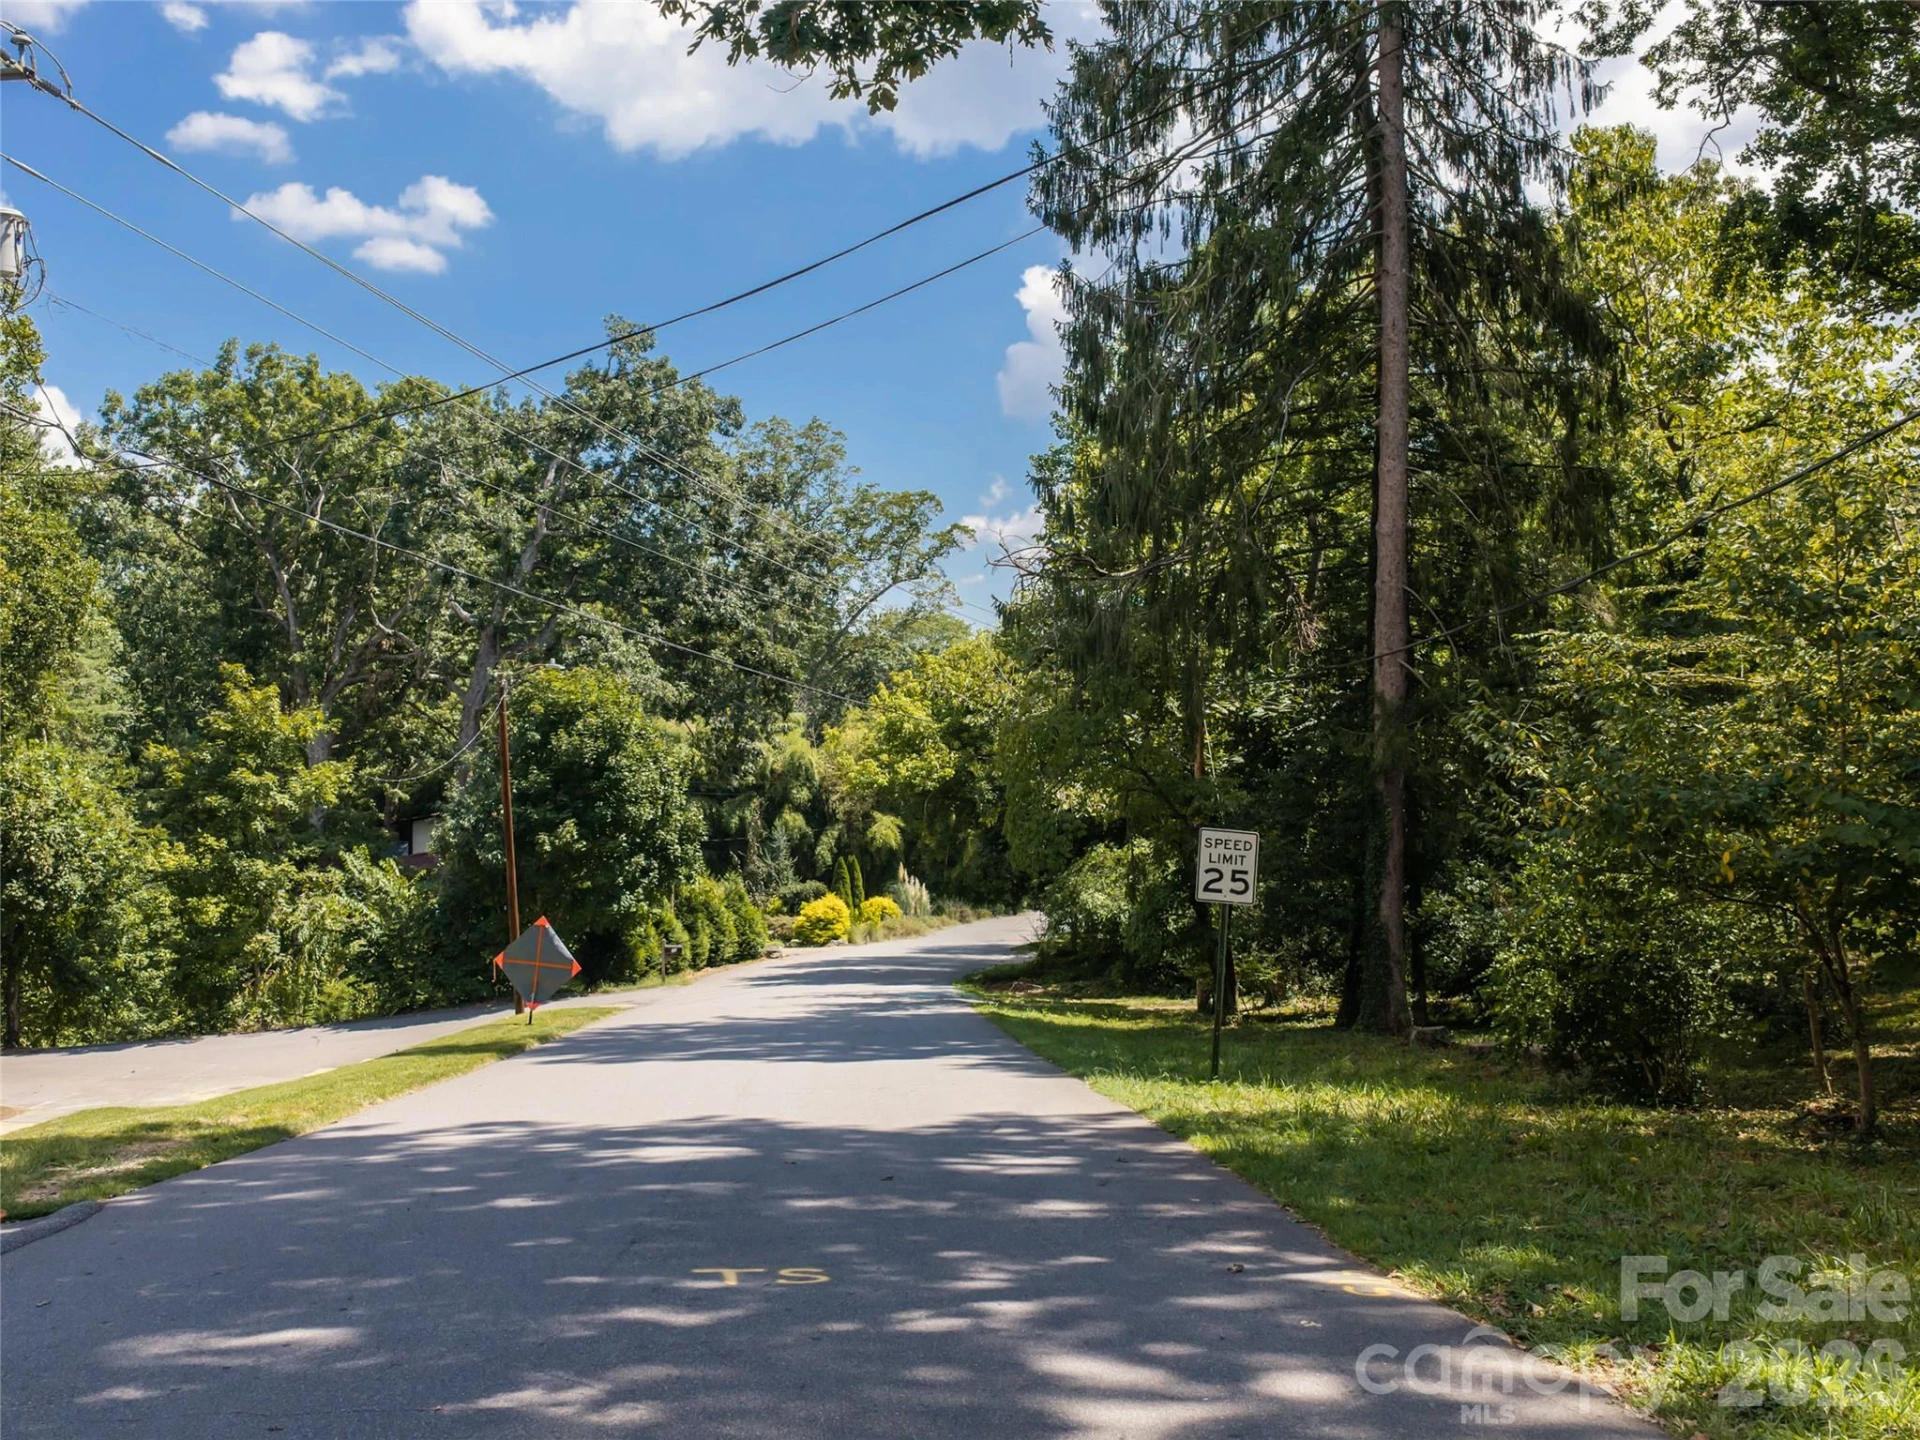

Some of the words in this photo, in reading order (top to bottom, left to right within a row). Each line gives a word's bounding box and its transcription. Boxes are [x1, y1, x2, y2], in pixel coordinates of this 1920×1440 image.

[1204, 838, 1253, 851] SPEED
[1208, 852, 1247, 866] LIMIT
[1203, 868, 1250, 896] 25
